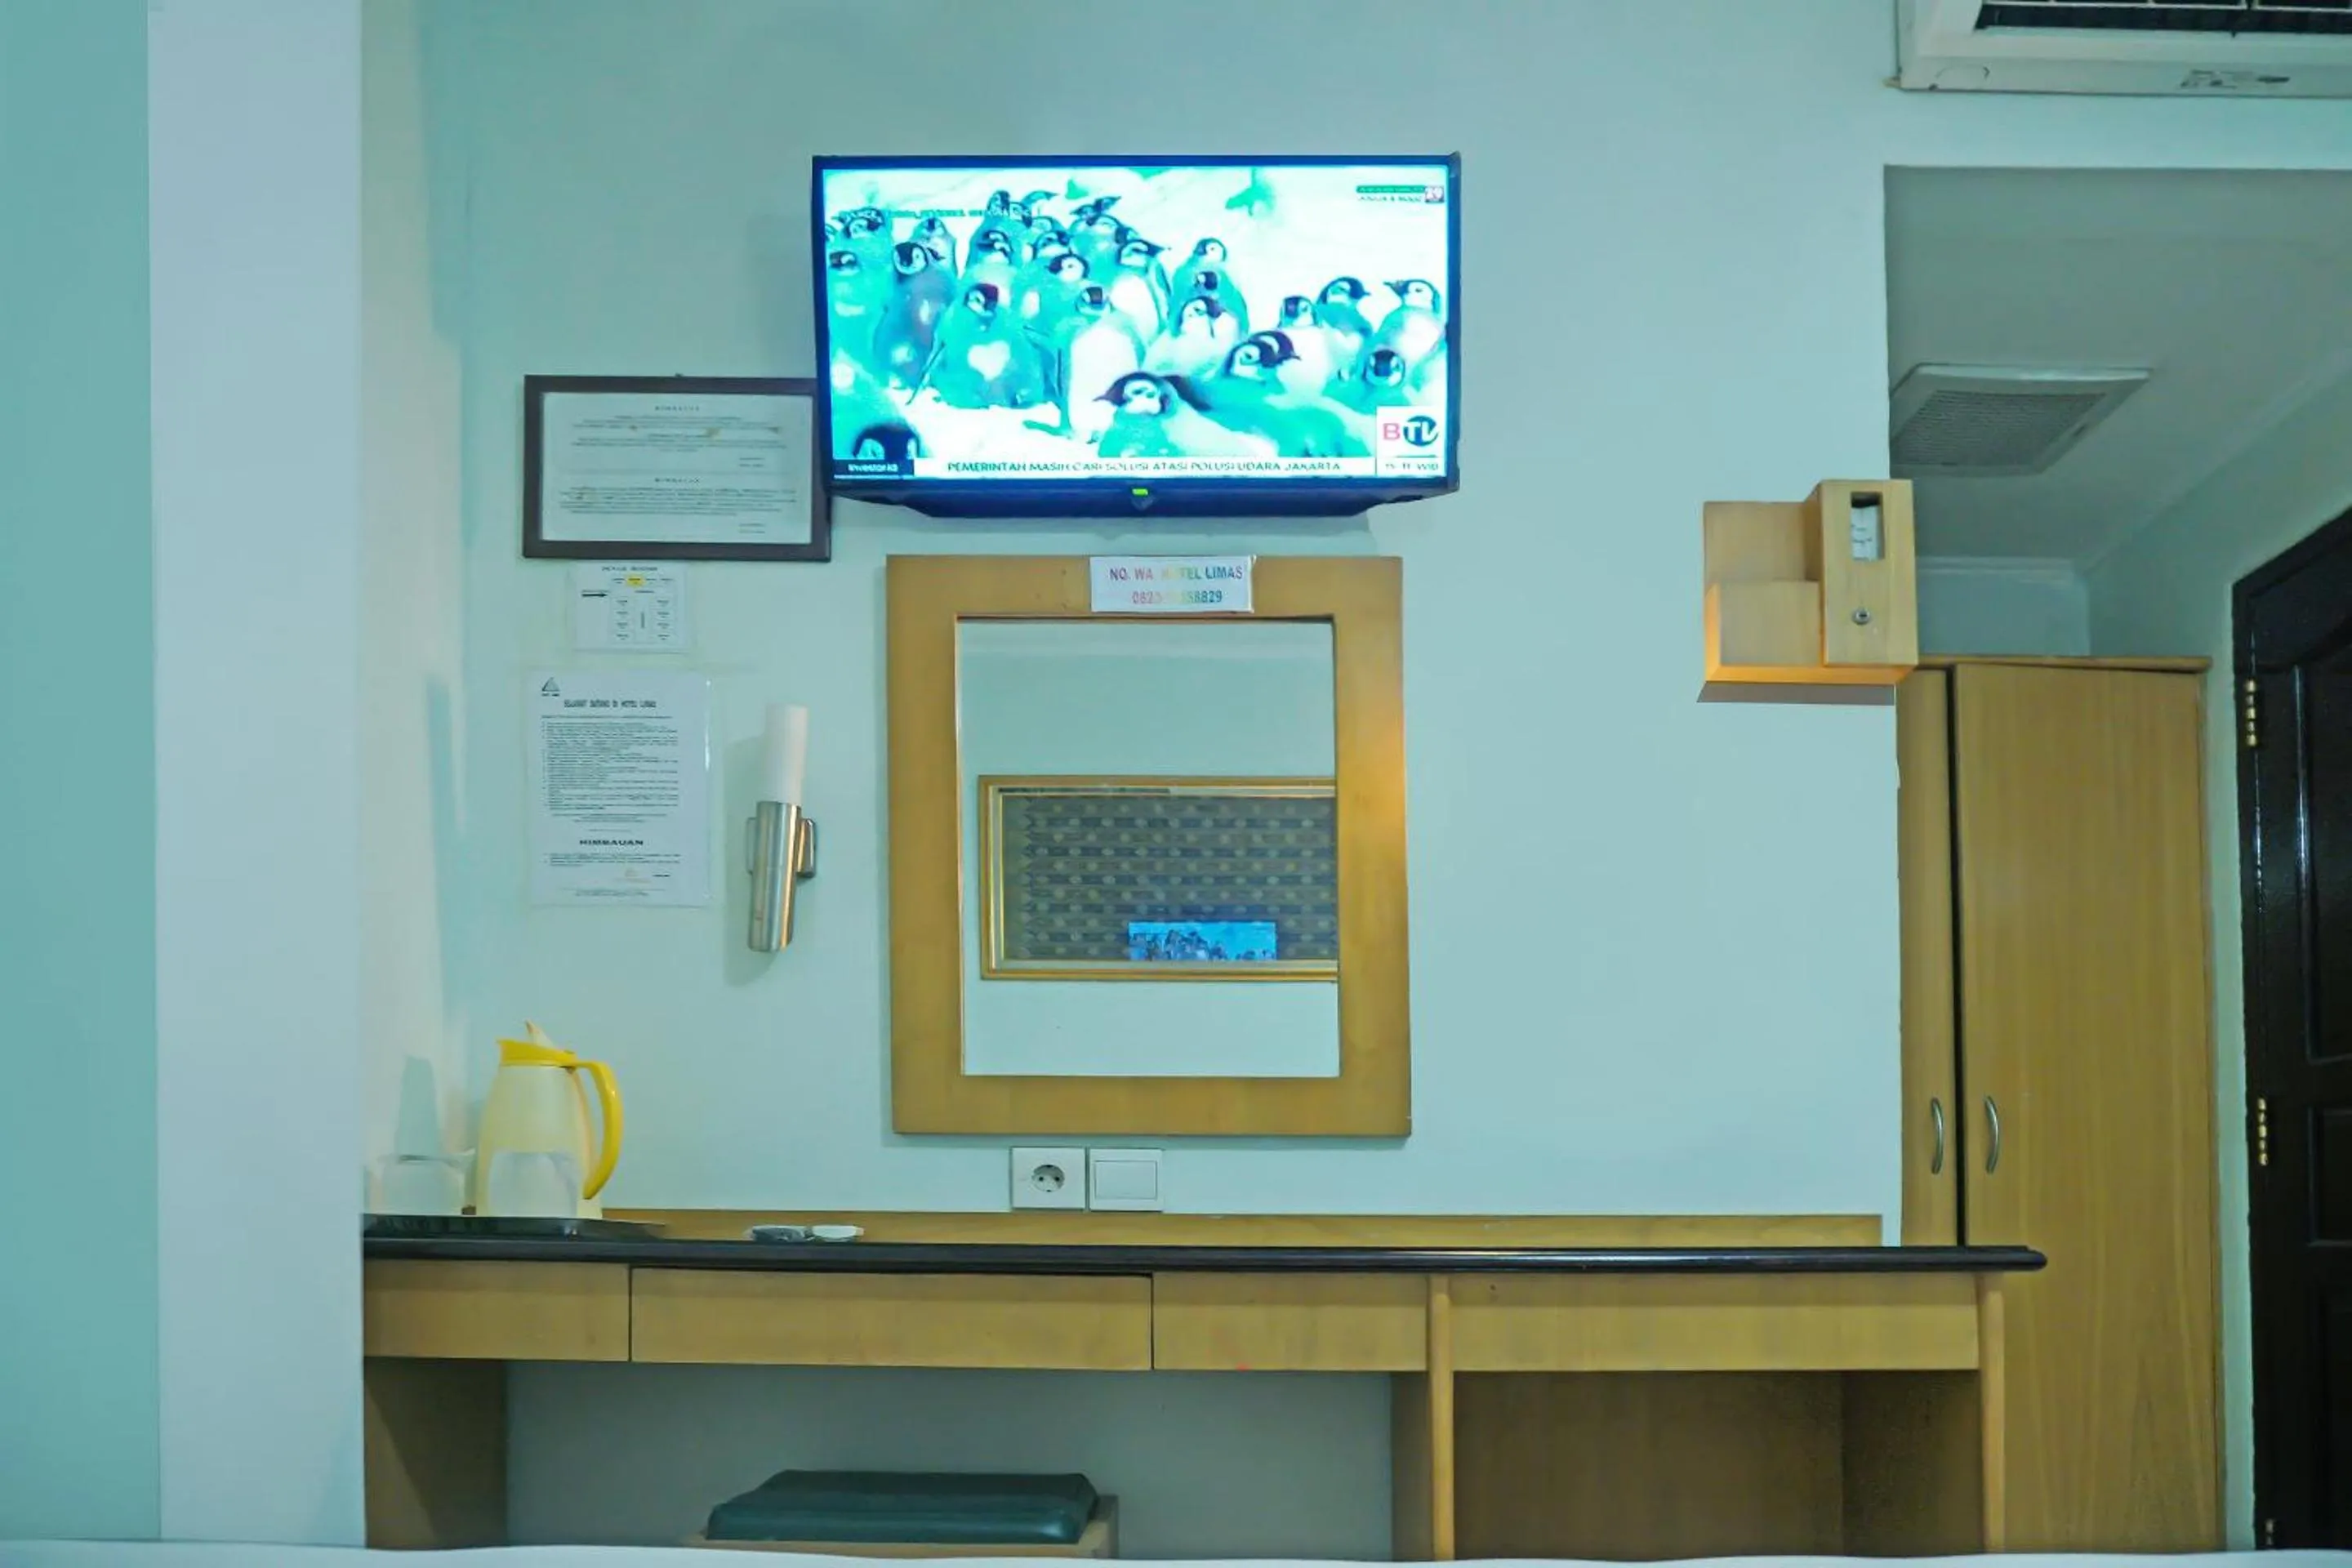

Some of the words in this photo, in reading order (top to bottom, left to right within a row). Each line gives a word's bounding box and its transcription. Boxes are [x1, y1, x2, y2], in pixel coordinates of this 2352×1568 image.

[947, 461, 1027, 472] PEMERINTAH
[1238, 461, 1281, 471] UDARA
[1284, 461, 1340, 471] JAKARTA
[1134, 568, 1154, 580] WA
[1161, 567, 1202, 580] HTEL
[1205, 566, 1244, 580] LIMAS
